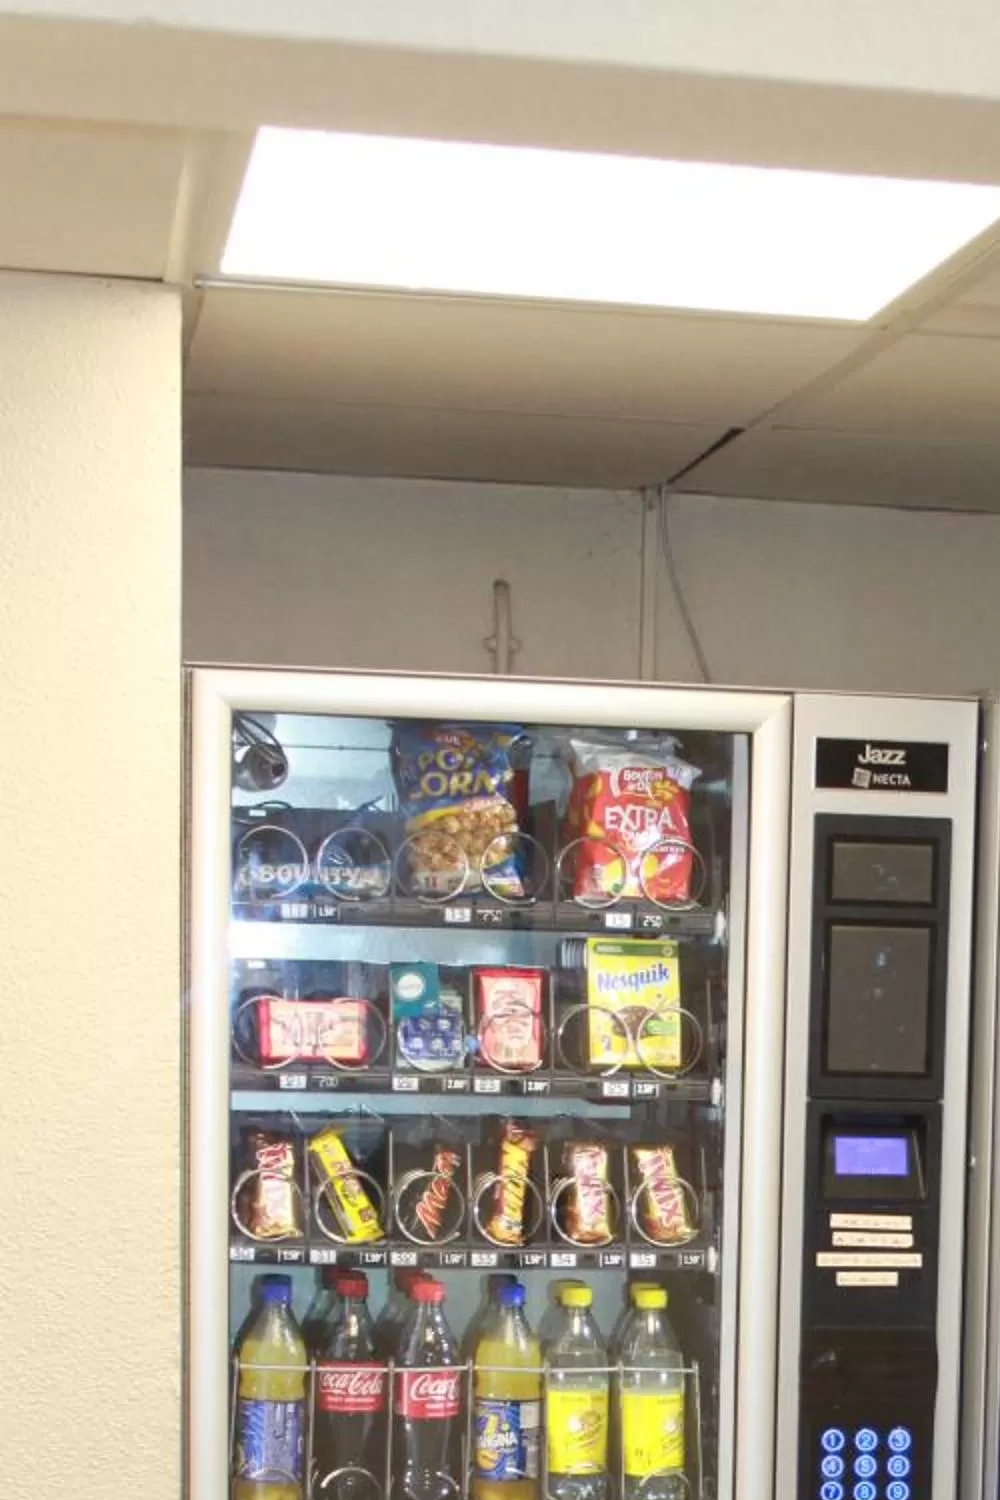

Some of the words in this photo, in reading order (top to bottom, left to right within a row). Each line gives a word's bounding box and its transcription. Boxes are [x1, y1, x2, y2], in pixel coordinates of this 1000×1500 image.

[857, 744, 906, 765] Jazz
[873, 774, 911, 787] NECTA
[604, 804, 677, 832] EXTRA
[597, 963, 669, 994] Nesquik
